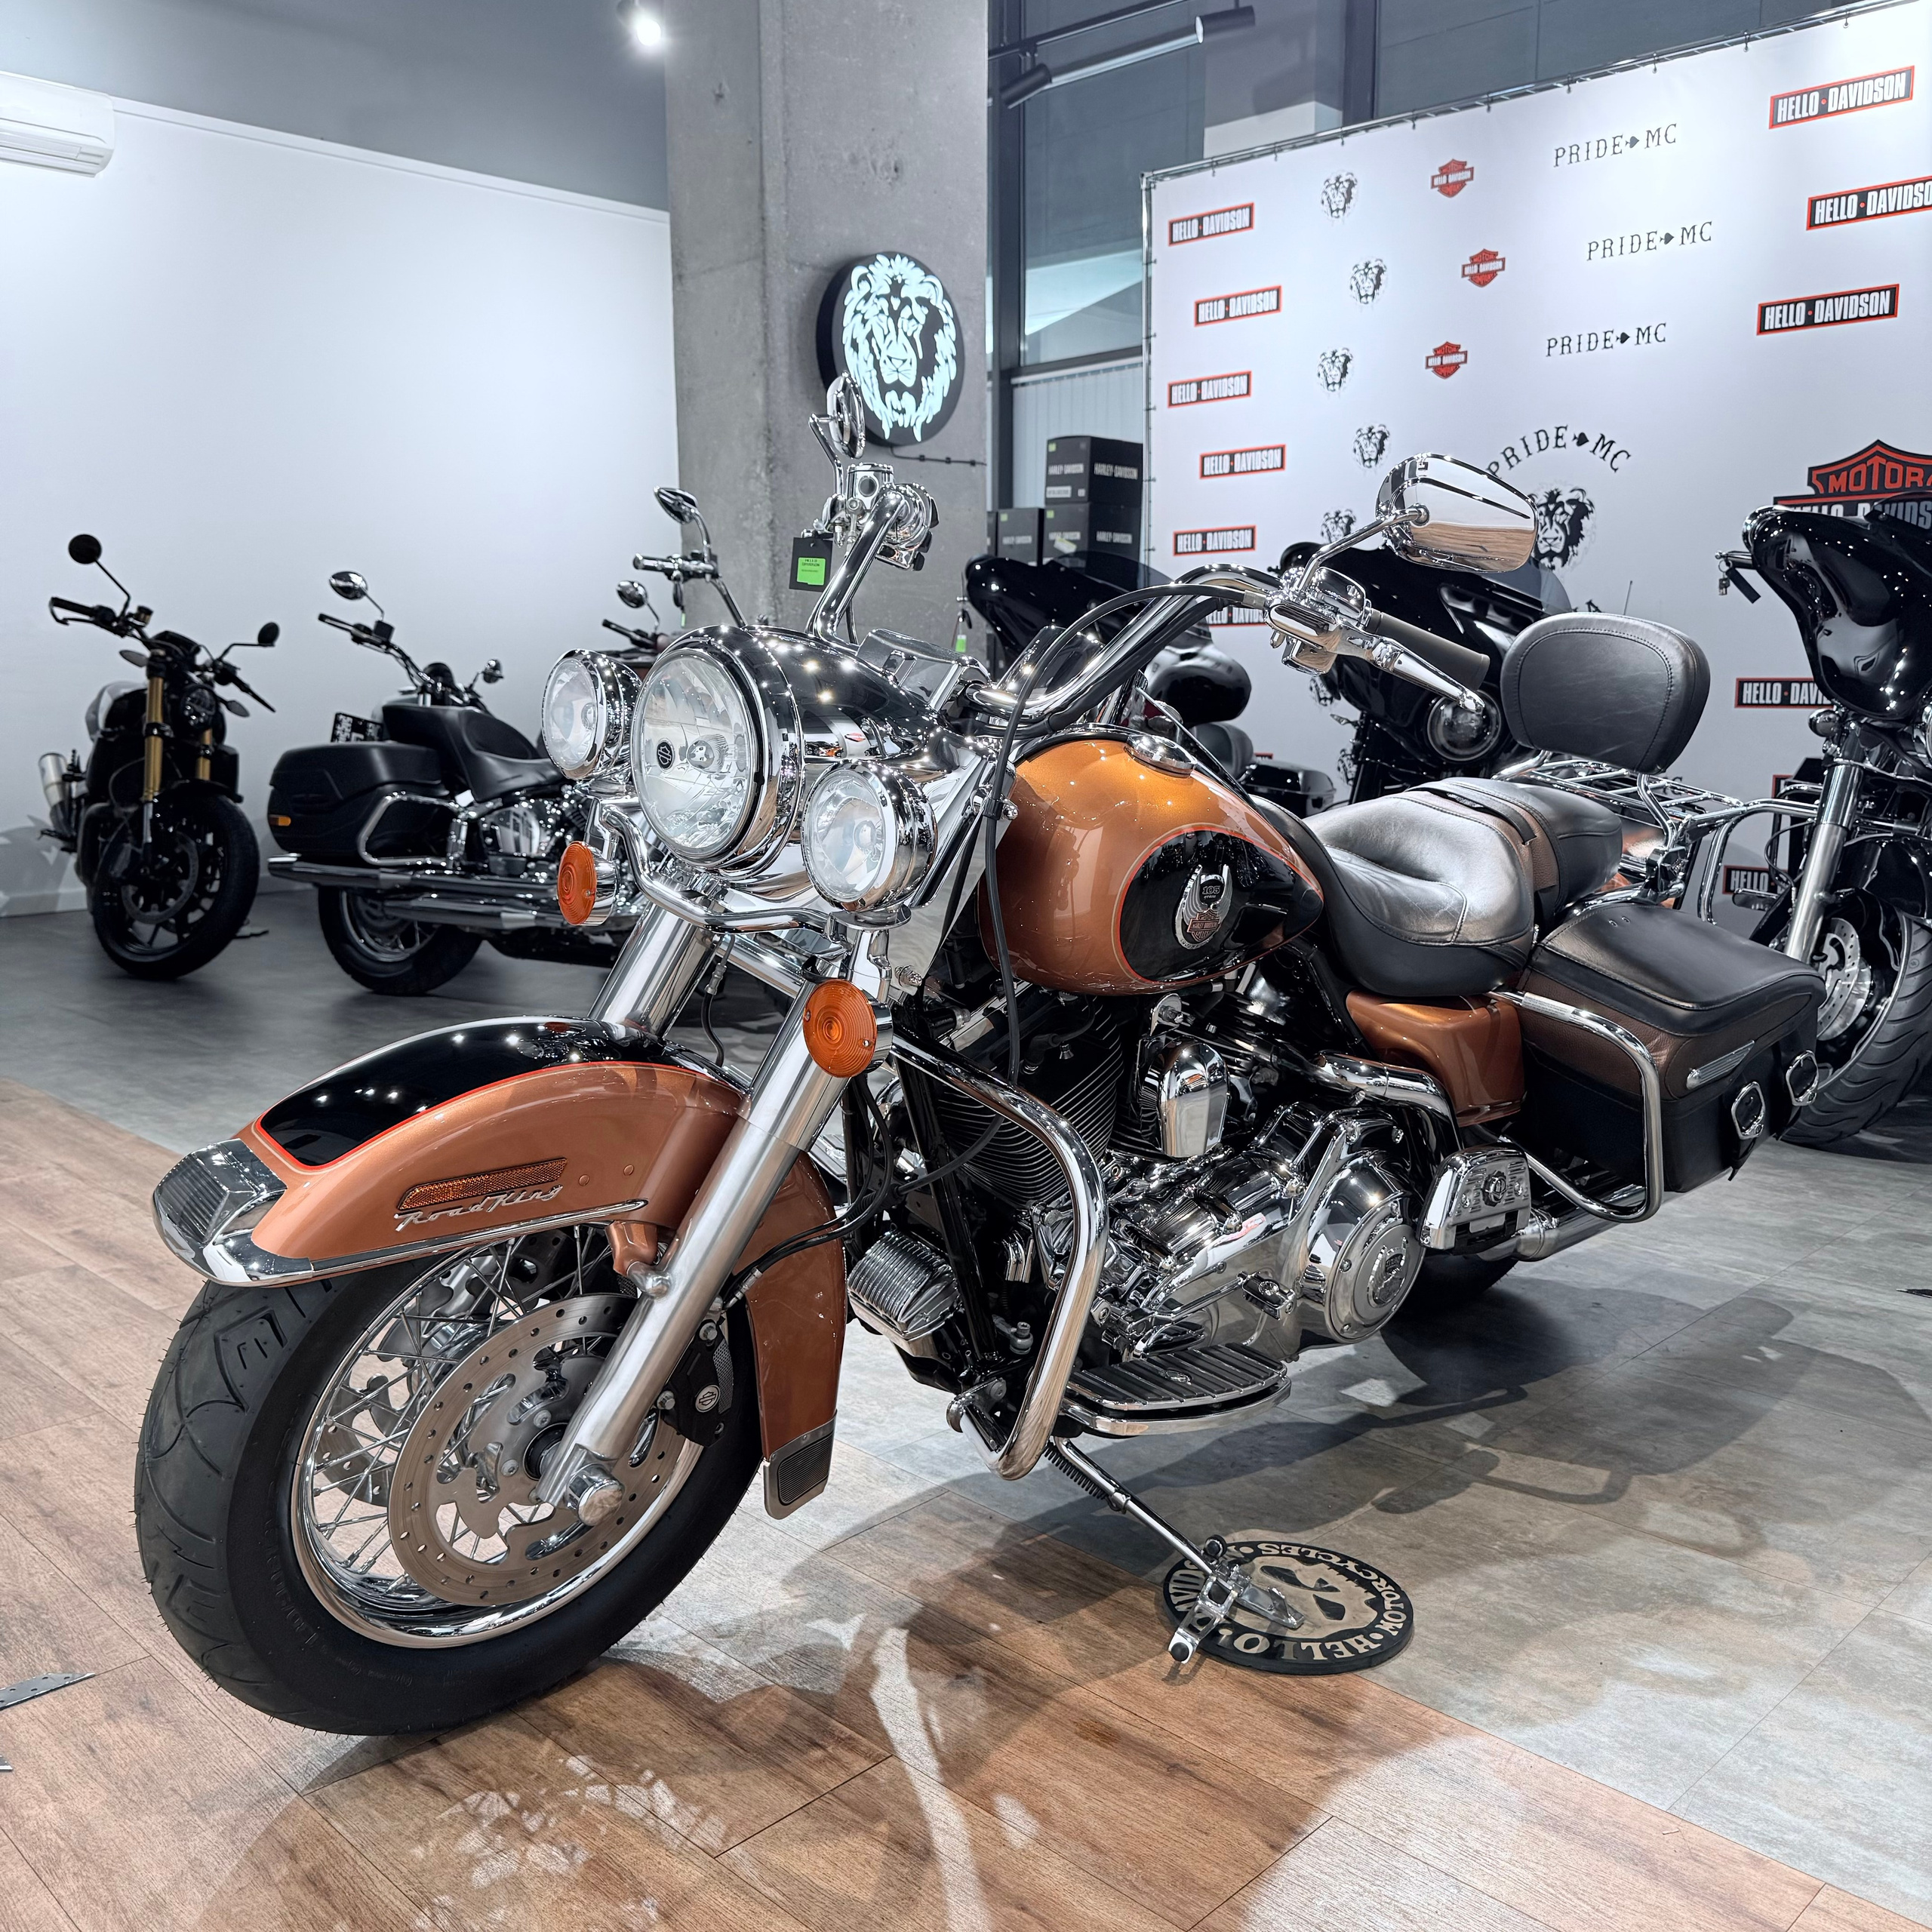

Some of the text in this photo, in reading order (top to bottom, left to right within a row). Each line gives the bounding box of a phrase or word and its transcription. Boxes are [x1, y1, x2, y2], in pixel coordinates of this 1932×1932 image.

[1777, 72, 1906, 122] HELLO DAVIDSON
[1553, 123, 1676, 168] PRIDE MC
[1815, 180, 1932, 224] HELLO DAVIDSO
[1172, 207, 1250, 242] HELLO DAVIDSON
[1586, 221, 1712, 261] PRIDE MC
[1198, 290, 1277, 323] HELLO DAVIDSON
[1764, 291, 1890, 330] HELLO DAVIDSON
[1546, 322, 1666, 357] PRIDE MC
[1171, 374, 1247, 405] HELLO DAVIDSON
[1204, 448, 1281, 475] HELLO DAVIDSON
[1485, 424, 1631, 479] PRIDE MC
[1829, 455, 1924, 494] MOTOR
[1177, 529, 1251, 552] HELLO DAVIDSON
[1743, 682, 1782, 704] HELLO
[1202, 886, 1220, 894] 105
[1730, 870, 1768, 892] HELLO
[1257, 1543, 1407, 1636] MOTORCYCLES
[1233, 1633, 1382, 1660] HELLO
